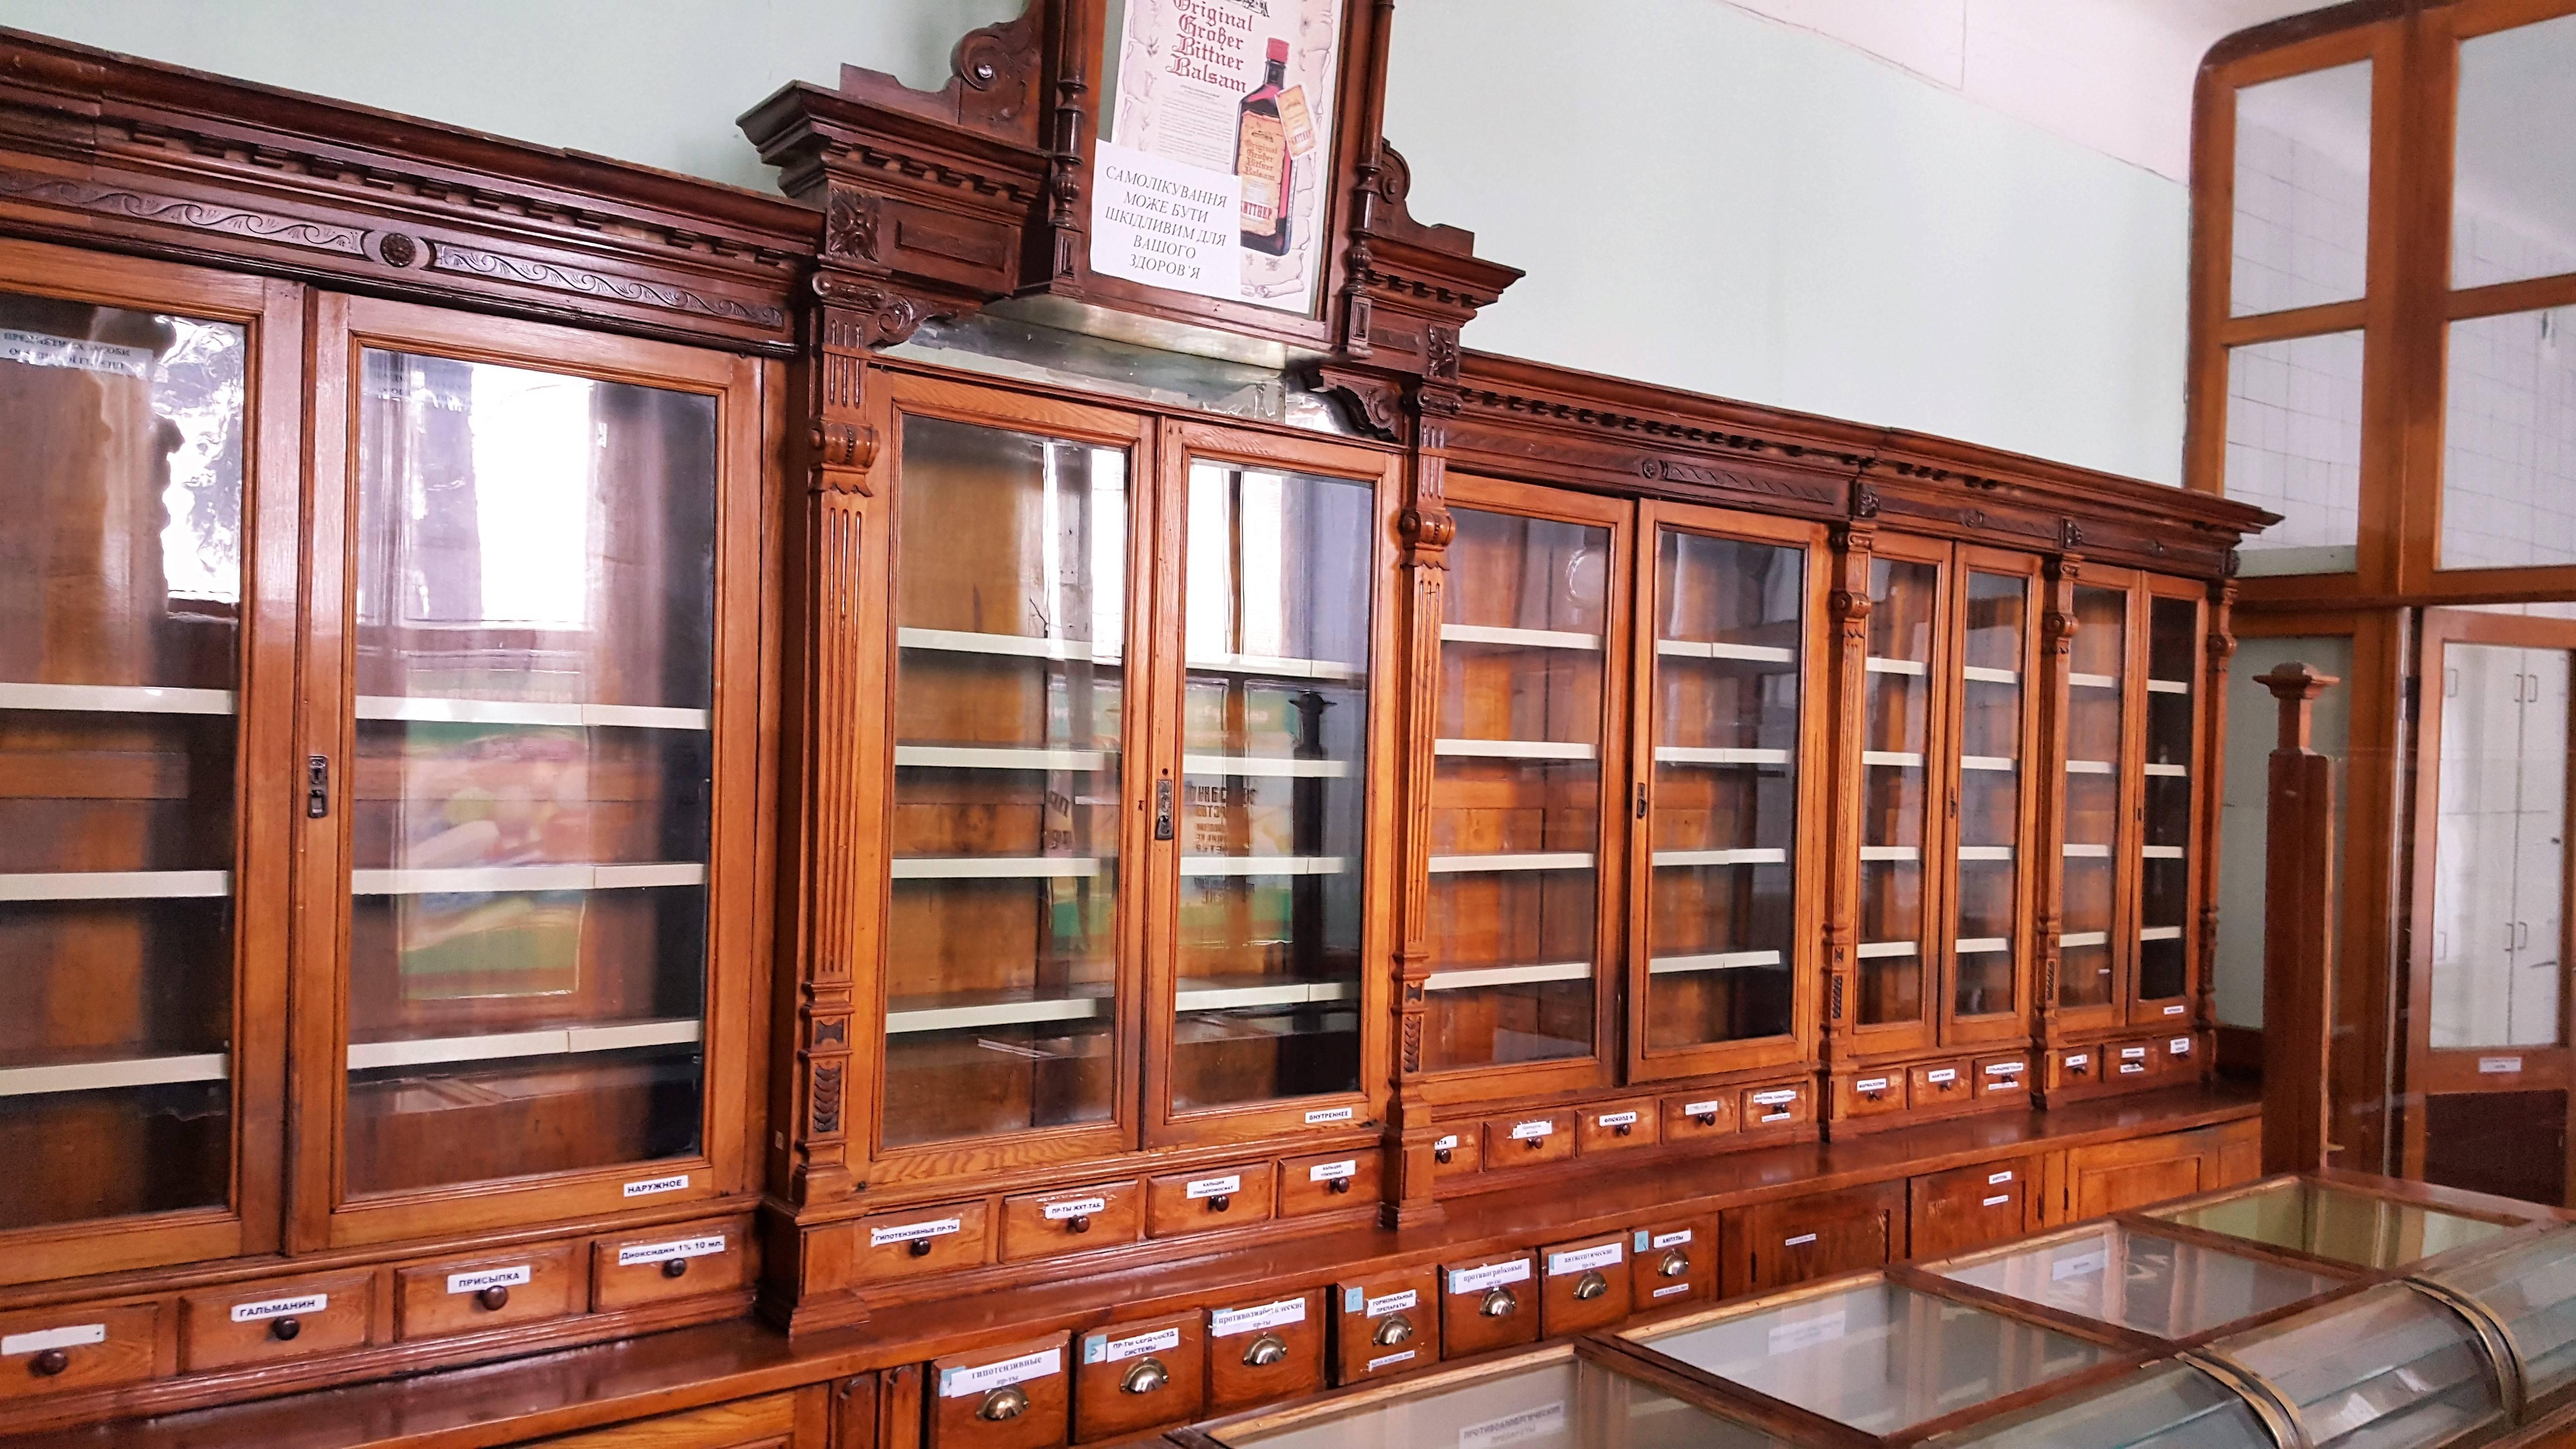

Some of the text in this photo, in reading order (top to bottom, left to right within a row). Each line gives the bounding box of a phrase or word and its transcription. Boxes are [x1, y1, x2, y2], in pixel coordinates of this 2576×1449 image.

[1172, 33, 1244, 70] Bittner
[1165, 53, 1247, 93] Balsam
[1106, 165, 1227, 208] САМОЛІКУВАННЯ
[1123, 191, 1208, 223] МОЖЕ БУТИ
[1105, 206, 1227, 246] ШКІДЛИВИМ ДЛЯ
[1133, 234, 1196, 259] ВАШОГО
[1128, 254, 1201, 279] ЗДОРОВ'Я
[1309, 1111, 1349, 1121] ВНУТРЕННЕЕ
[627, 1179, 682, 1194] НАРУЖНОЕ
[875, 1227, 935, 1241] ГИПОТЕНЗИВНЫЕ
[620, 1247, 675, 1261] Диоксидин
[459, 1272, 519, 1287] ПРИСЫПКА
[240, 1300, 315, 1317] ГАЛЬМАНИН
[971, 1356, 1042, 1380] гипотензивные
